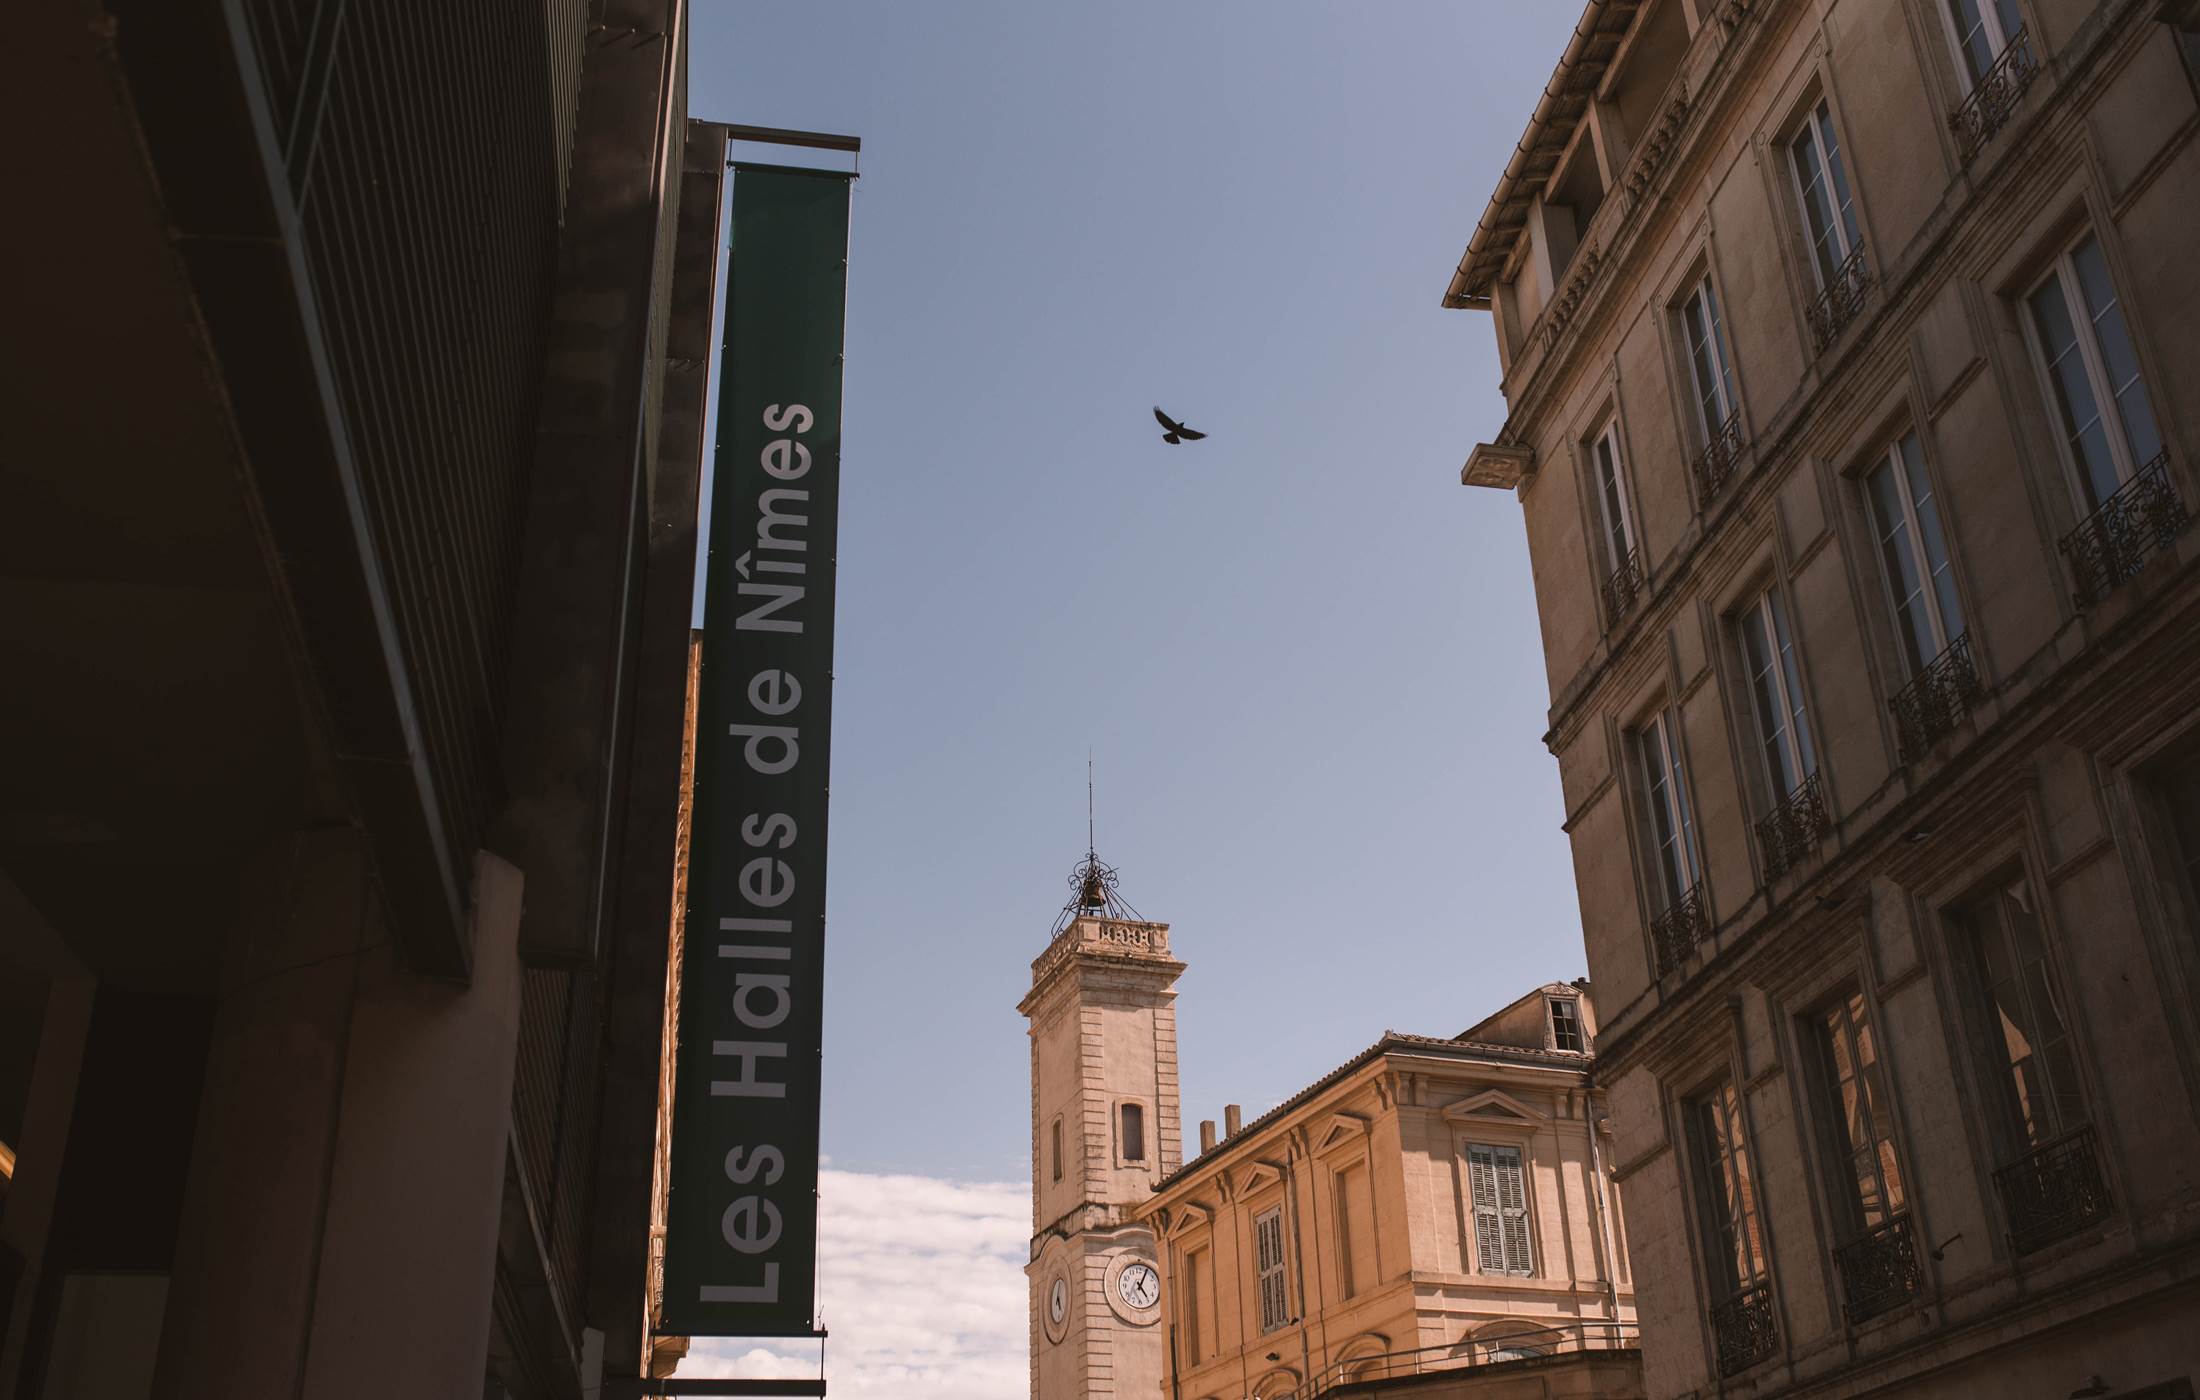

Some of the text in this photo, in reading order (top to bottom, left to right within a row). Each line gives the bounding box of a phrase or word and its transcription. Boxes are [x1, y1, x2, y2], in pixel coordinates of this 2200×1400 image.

[700, 403, 815, 1303] Les Halles de Nîmes
